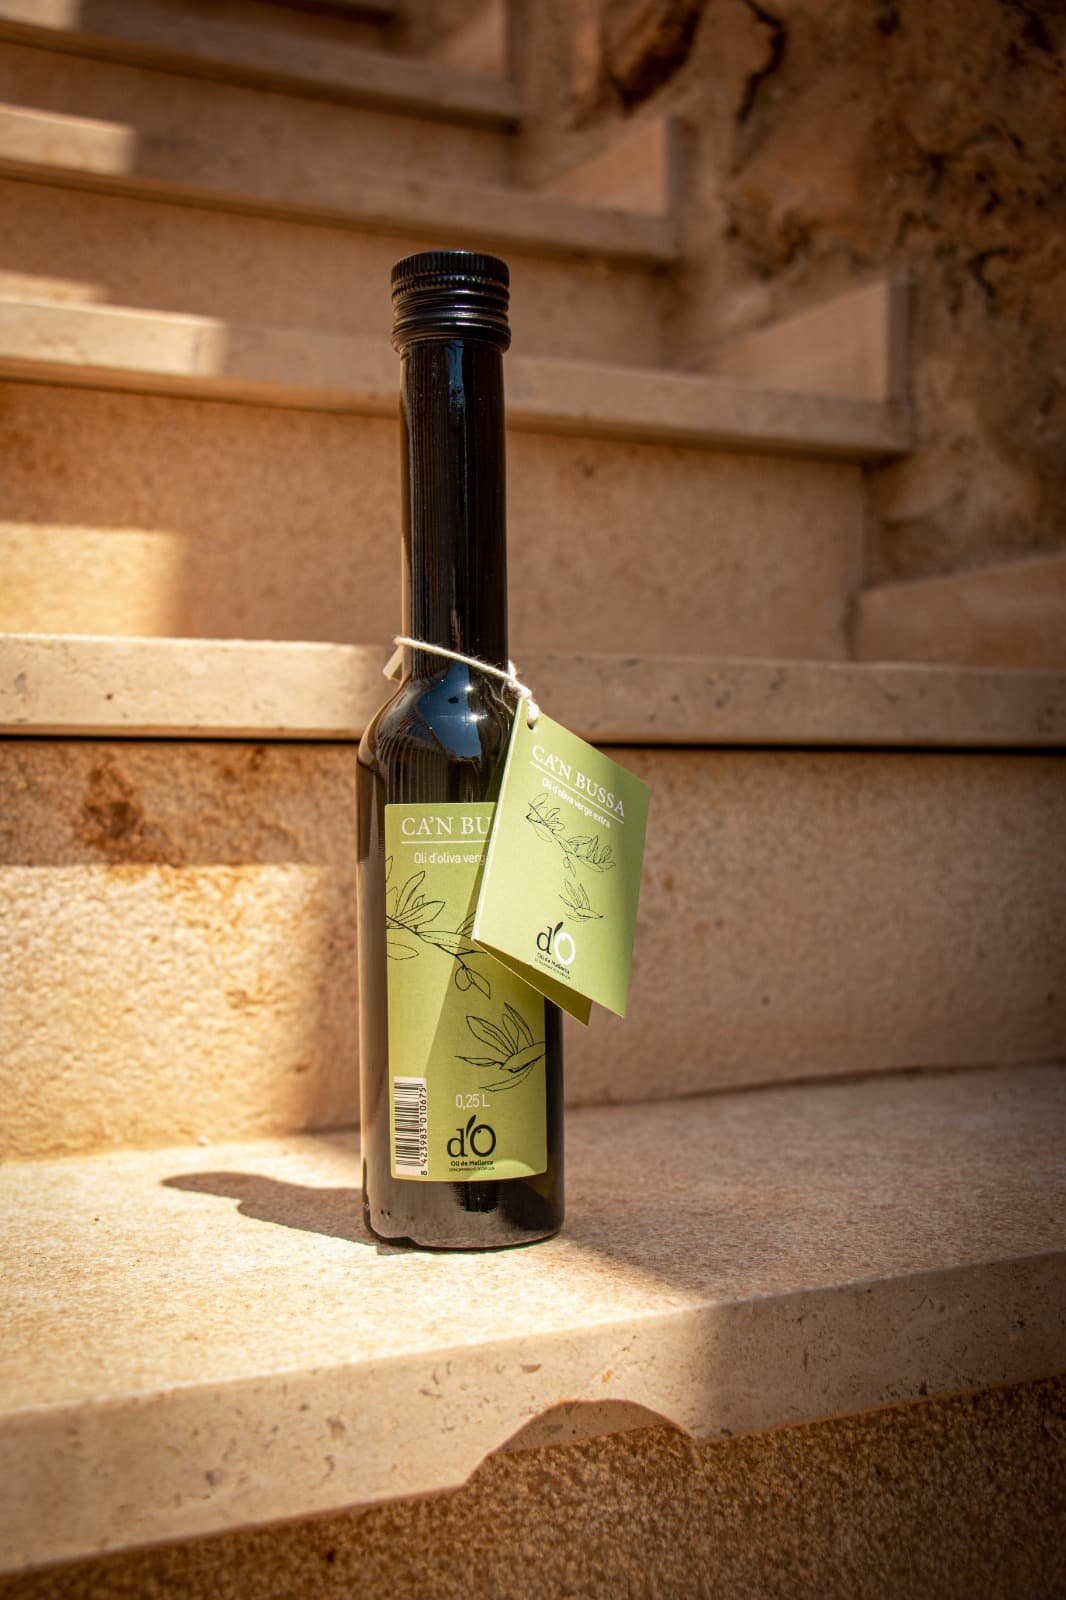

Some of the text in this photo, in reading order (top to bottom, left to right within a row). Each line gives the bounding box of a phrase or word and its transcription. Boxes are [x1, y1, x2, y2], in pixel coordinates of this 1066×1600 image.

[532, 744, 625, 818] CA'N BUSSA
[401, 816, 453, 836] CA'N
[414, 852, 427, 864] Oli
[463, 853, 487, 866] verg
[455, 1094, 491, 1110] 0,25 L
